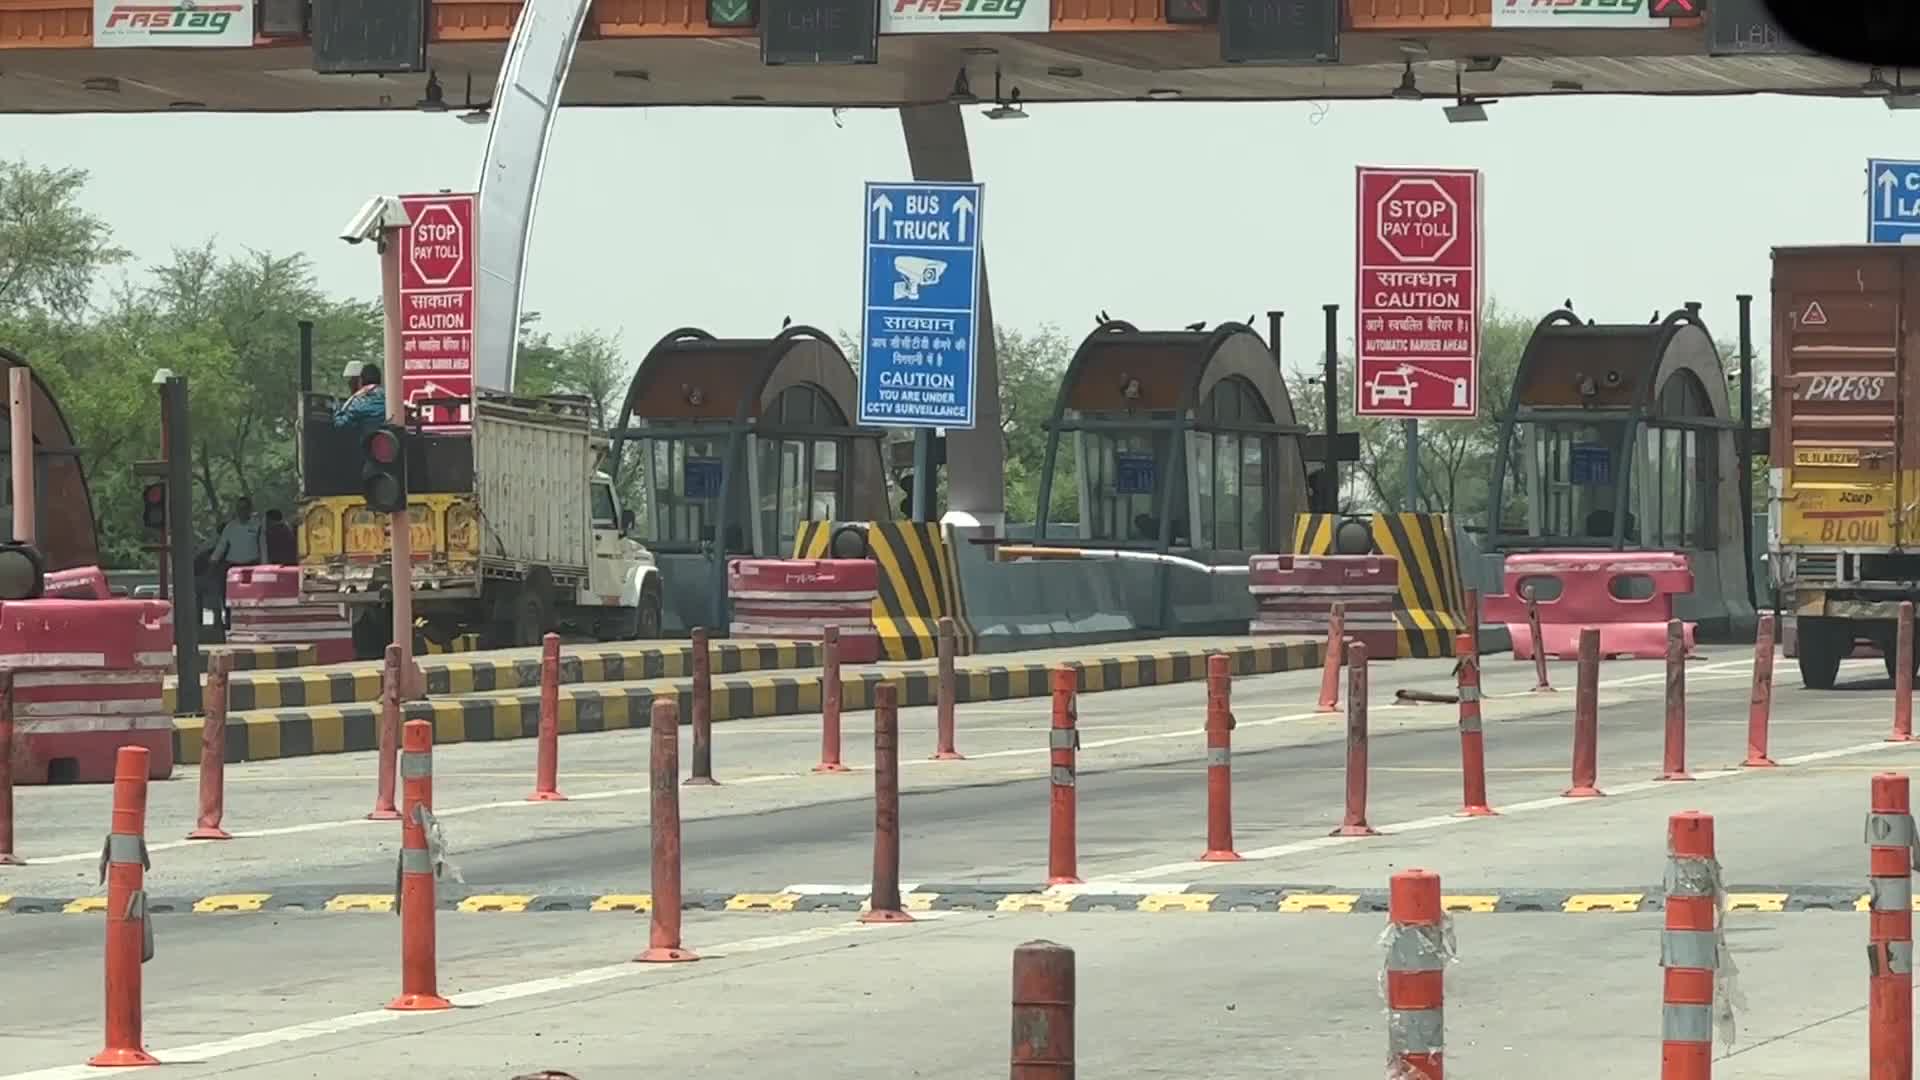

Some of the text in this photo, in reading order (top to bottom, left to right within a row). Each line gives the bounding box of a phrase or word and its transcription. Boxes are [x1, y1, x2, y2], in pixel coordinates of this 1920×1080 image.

[905, 194, 940, 215] BUS
[1388, 200, 1447, 218] STOP
[418, 224, 456, 242] STOP
[892, 219, 950, 241] TRUCK
[1382, 222, 1451, 237] PAY TOLL
[414, 245, 459, 260] PAY TOLL
[1375, 272, 1458, 288] सावधान
[409, 294, 464, 309] सावधान
[1374, 292, 1460, 308] CAUTION
[409, 314, 464, 329] CAUTION
[882, 316, 956, 332] सावधान
[1365, 339, 1408, 351] AUTOMATIC
[1442, 339, 1468, 351] AHEAD
[879, 371, 955, 388] CAUTION
[879, 389, 956, 404] YOU ARE UNDER
[1805, 376, 1885, 401] PRESS
[867, 402, 967, 417] CCTV SURVEILLANCE
[1839, 491, 1873, 505] Keep
[1820, 519, 1881, 542] BLOW
